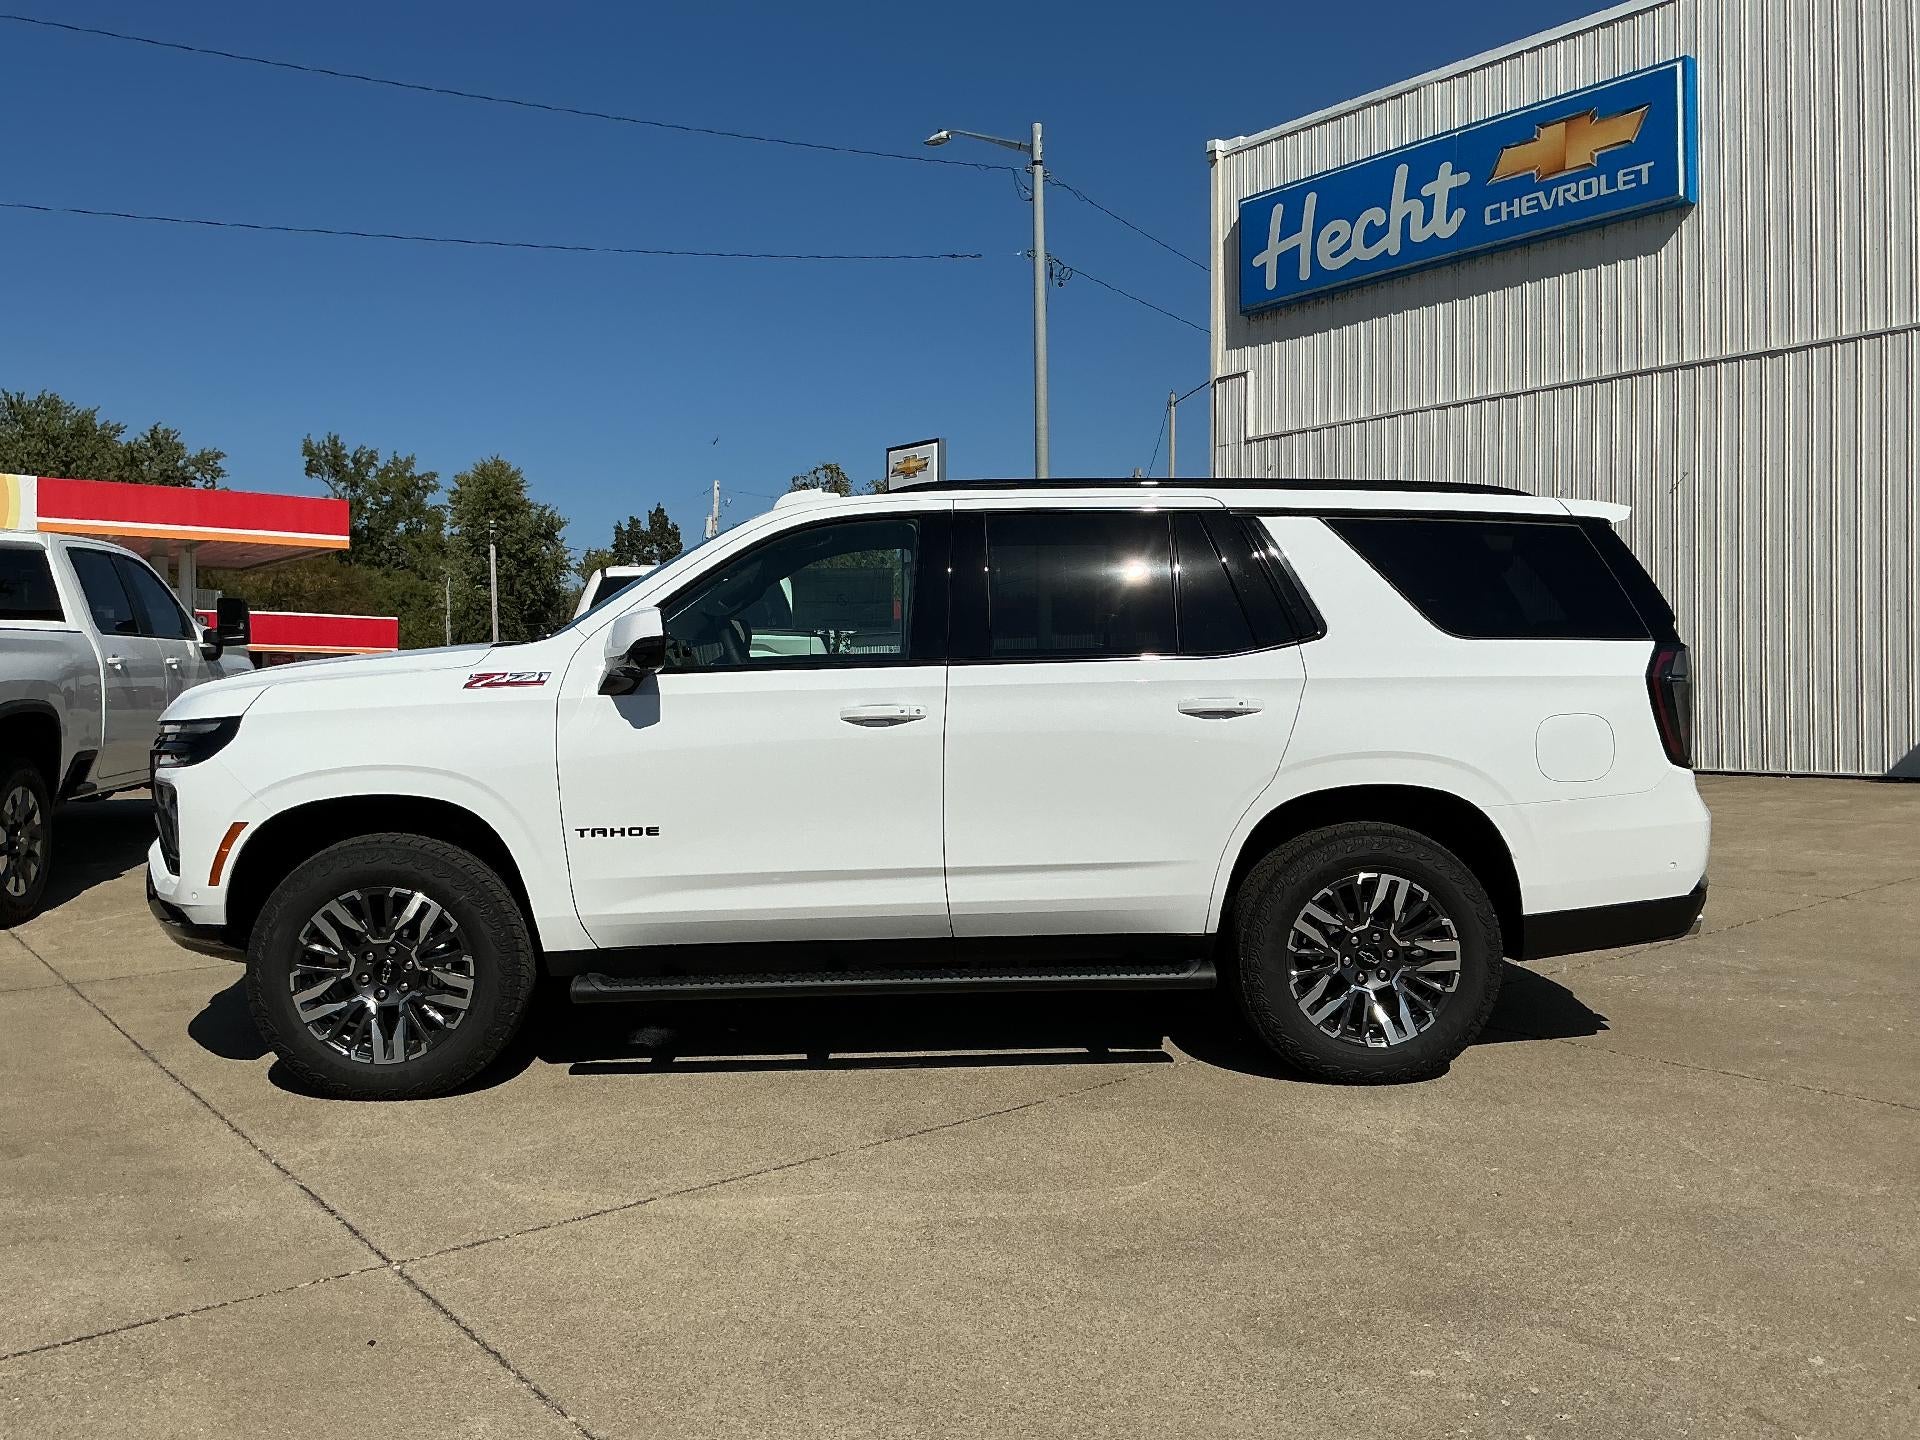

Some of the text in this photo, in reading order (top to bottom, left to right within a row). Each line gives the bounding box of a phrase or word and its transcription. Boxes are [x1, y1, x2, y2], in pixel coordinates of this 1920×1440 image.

[1485, 161, 1655, 225] CHEVROLET
[1252, 161, 1470, 290] Hecht
[463, 671, 552, 689] Z71
[574, 826, 660, 838] TAHOE
